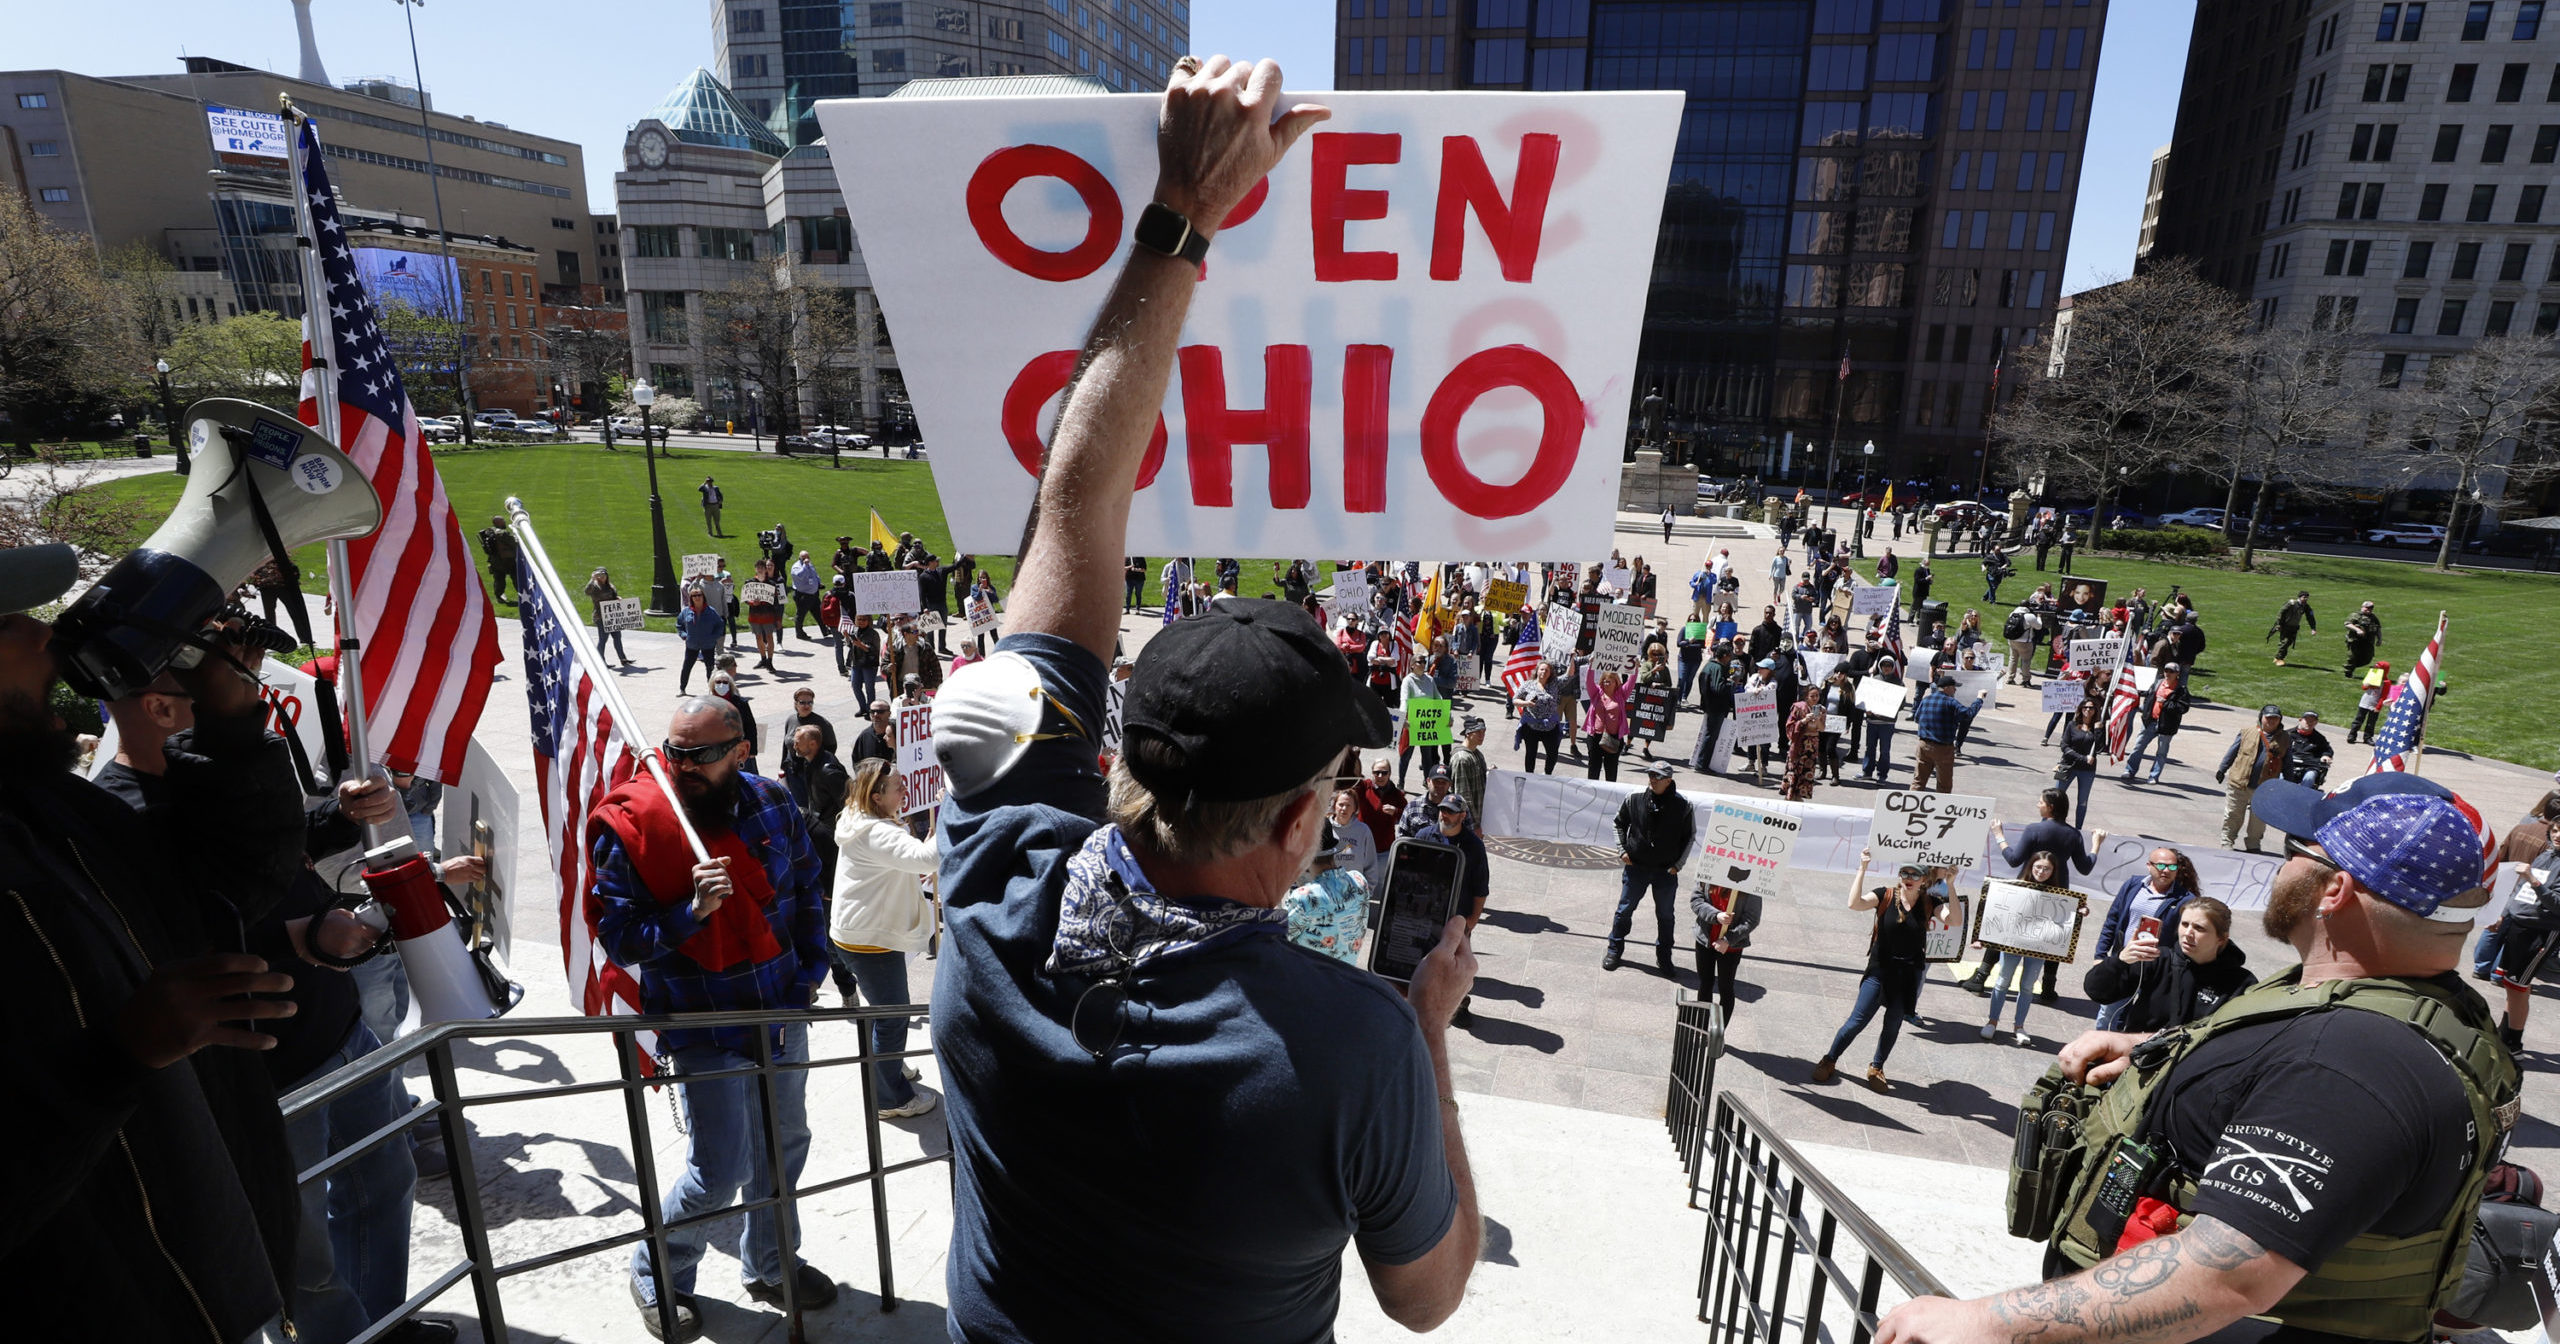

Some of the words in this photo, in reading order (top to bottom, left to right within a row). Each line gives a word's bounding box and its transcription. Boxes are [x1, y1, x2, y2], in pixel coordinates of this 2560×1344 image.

[211, 116, 237, 128] SEE
[241, 119, 276, 132] CUTE
[966, 132, 1561, 283] OEN
[300, 463, 317, 481] NOW
[313, 457, 329, 474] BAIL
[307, 460, 331, 489] REFORM
[1560, 562, 1574, 572] NO
[1341, 572, 1359, 583] LET
[1339, 586, 1364, 599] OHIO
[603, 602, 622, 613] FEAR
[1551, 602, 1563, 617] WE
[1546, 612, 1579, 639] NEVER
[1602, 609, 1642, 626] MODELS
[1598, 626, 1639, 646] WRONG
[1605, 643, 1629, 653] OHIO
[2076, 643, 2092, 652] ALL
[2098, 642, 2120, 650] JOB
[2091, 650, 2111, 658] ARE
[1595, 651, 1624, 663] PHASE
[1624, 654, 1637, 671] 3
[1596, 662, 1621, 672] NOW
[1416, 708, 1442, 718] FACTS
[1420, 720, 1436, 729] NOT
[1417, 731, 1438, 741] FEAR
[914, 747, 923, 762] IS
[1885, 791, 1937, 814] CDC
[1944, 803, 1987, 820] owns
[1905, 812, 1957, 840] 57
[1710, 824, 1785, 855] SEND
[1877, 833, 1932, 851] Vaccine
[1556, 859, 1588, 867] OF
[1705, 844, 1778, 870] HEALTHY
[2215, 1146, 2231, 1155] US
[2224, 1124, 2274, 1137] GRUNT
[2274, 1131, 2334, 1168] STYLE
[2230, 1163, 2267, 1186] GS
[2285, 1163, 2325, 1192] 1776
[2214, 1180, 2243, 1195] WE'LL
[2244, 1189, 2301, 1223] DEFEND
